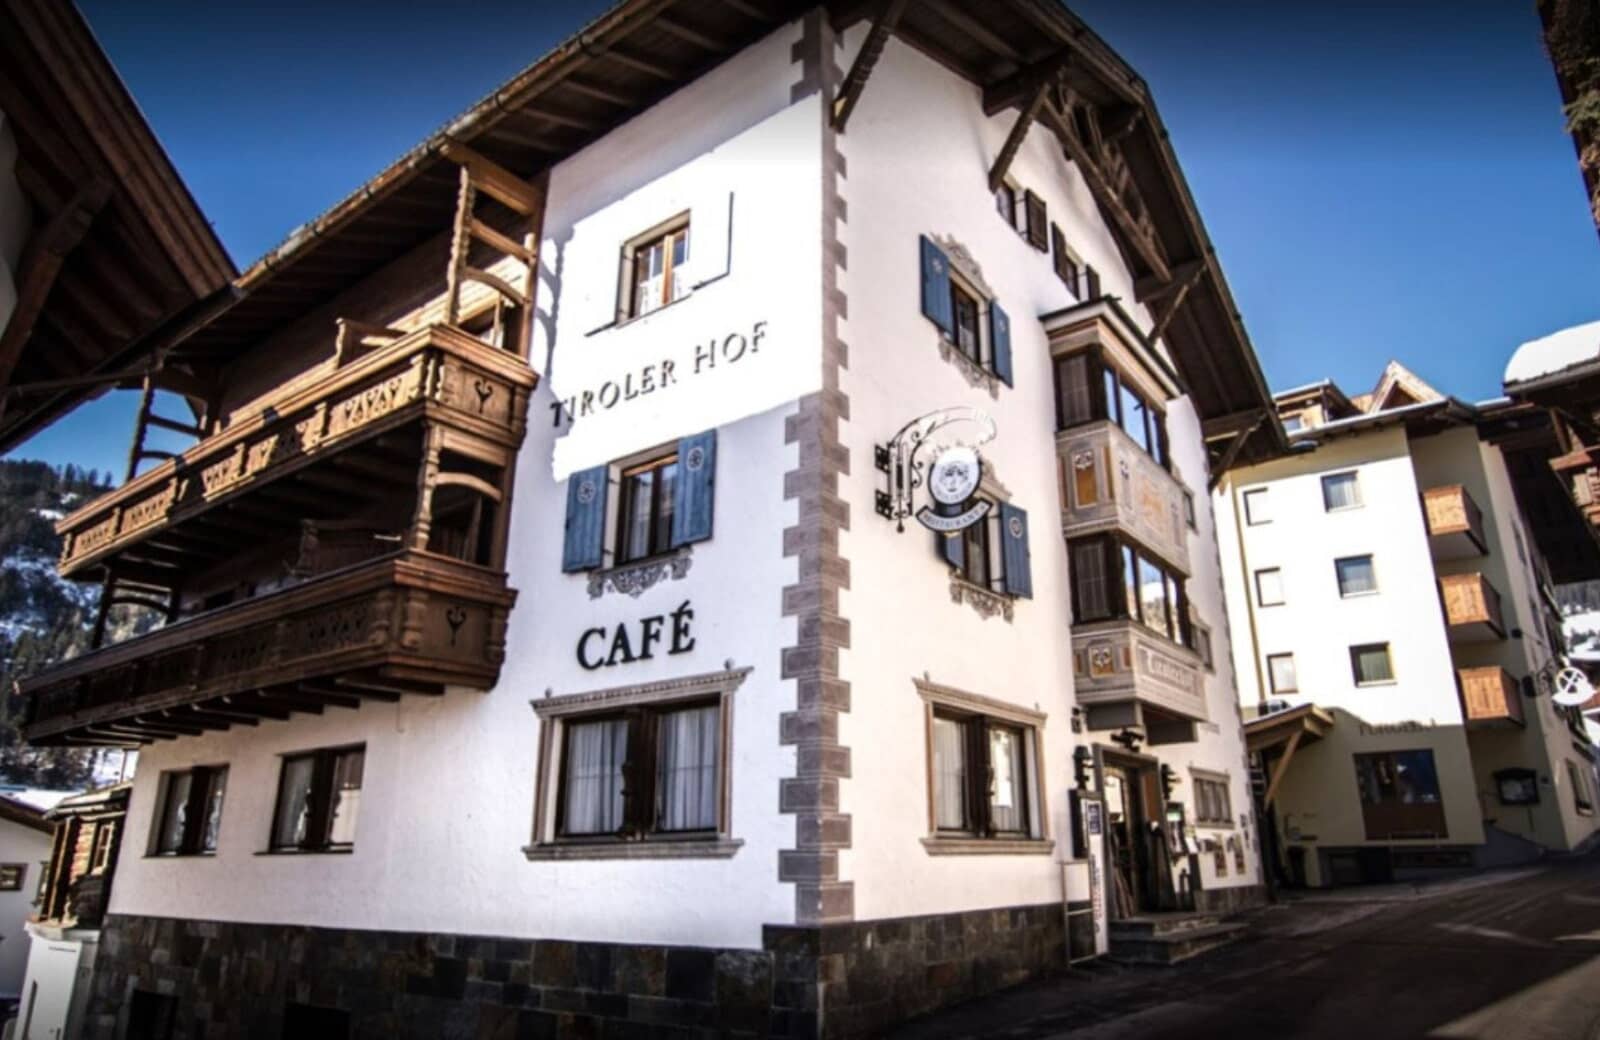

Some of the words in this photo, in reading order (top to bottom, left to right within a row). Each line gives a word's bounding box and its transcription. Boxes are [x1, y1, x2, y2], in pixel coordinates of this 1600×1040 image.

[550, 359, 677, 428] TIROLER
[694, 320, 768, 374] HOF
[576, 600, 696, 671] CAFÉ
